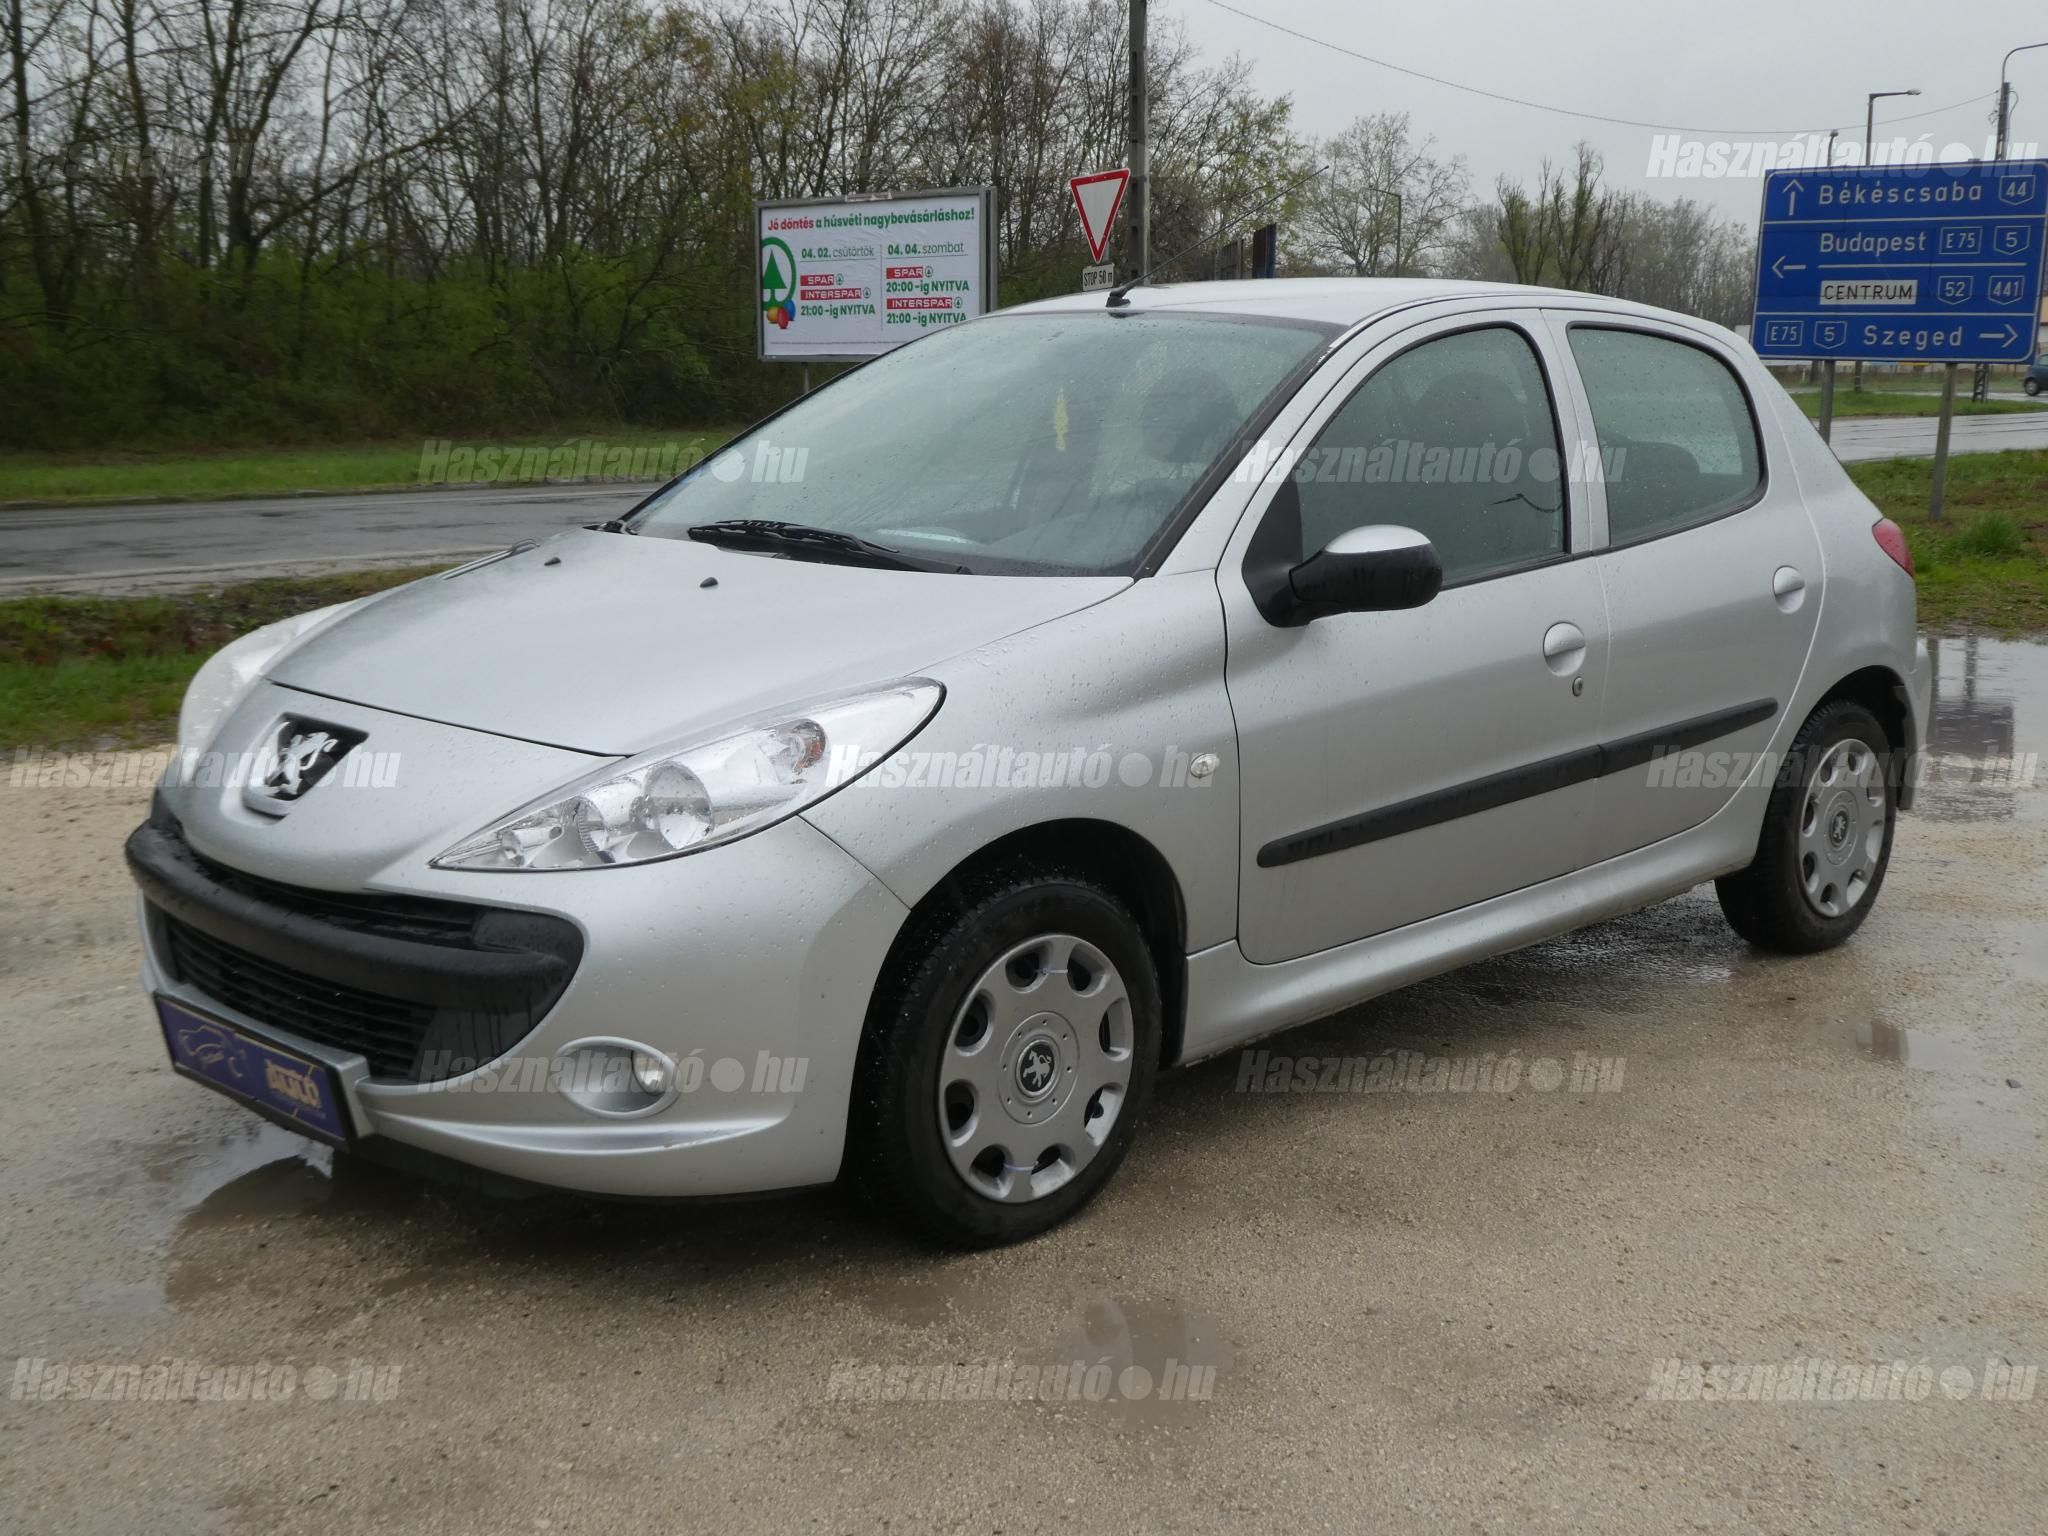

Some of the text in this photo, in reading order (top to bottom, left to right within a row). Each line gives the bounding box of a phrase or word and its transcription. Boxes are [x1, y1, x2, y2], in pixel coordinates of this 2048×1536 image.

[1818, 180, 2027, 205] Békéscsaba 44
[767, 207, 975, 231] Jó döntés a húsvéti nagybevásárláshoz!
[922, 241, 964, 255] szombat
[1819, 231, 1927, 256] Budapest
[2005, 231, 2018, 248] 5
[832, 245, 875, 258] csütörtök
[894, 268, 923, 278] SPAR
[1083, 271, 1097, 286] STOP
[1098, 269, 1106, 284] 50
[807, 276, 834, 285] SPAR
[886, 281, 913, 292] 20:00
[931, 280, 969, 292] NYITVA
[805, 289, 861, 299] INTERSPAR
[1824, 281, 2019, 300] CENTRUM 52 441
[801, 305, 823, 316] 21:00
[840, 303, 876, 315] NYITVA
[892, 298, 952, 308] INTERSPAR
[886, 313, 911, 324] 21:00
[929, 312, 966, 324] NYITVA
[1824, 326, 1835, 342] 5
[1863, 325, 1964, 351] Szeged
